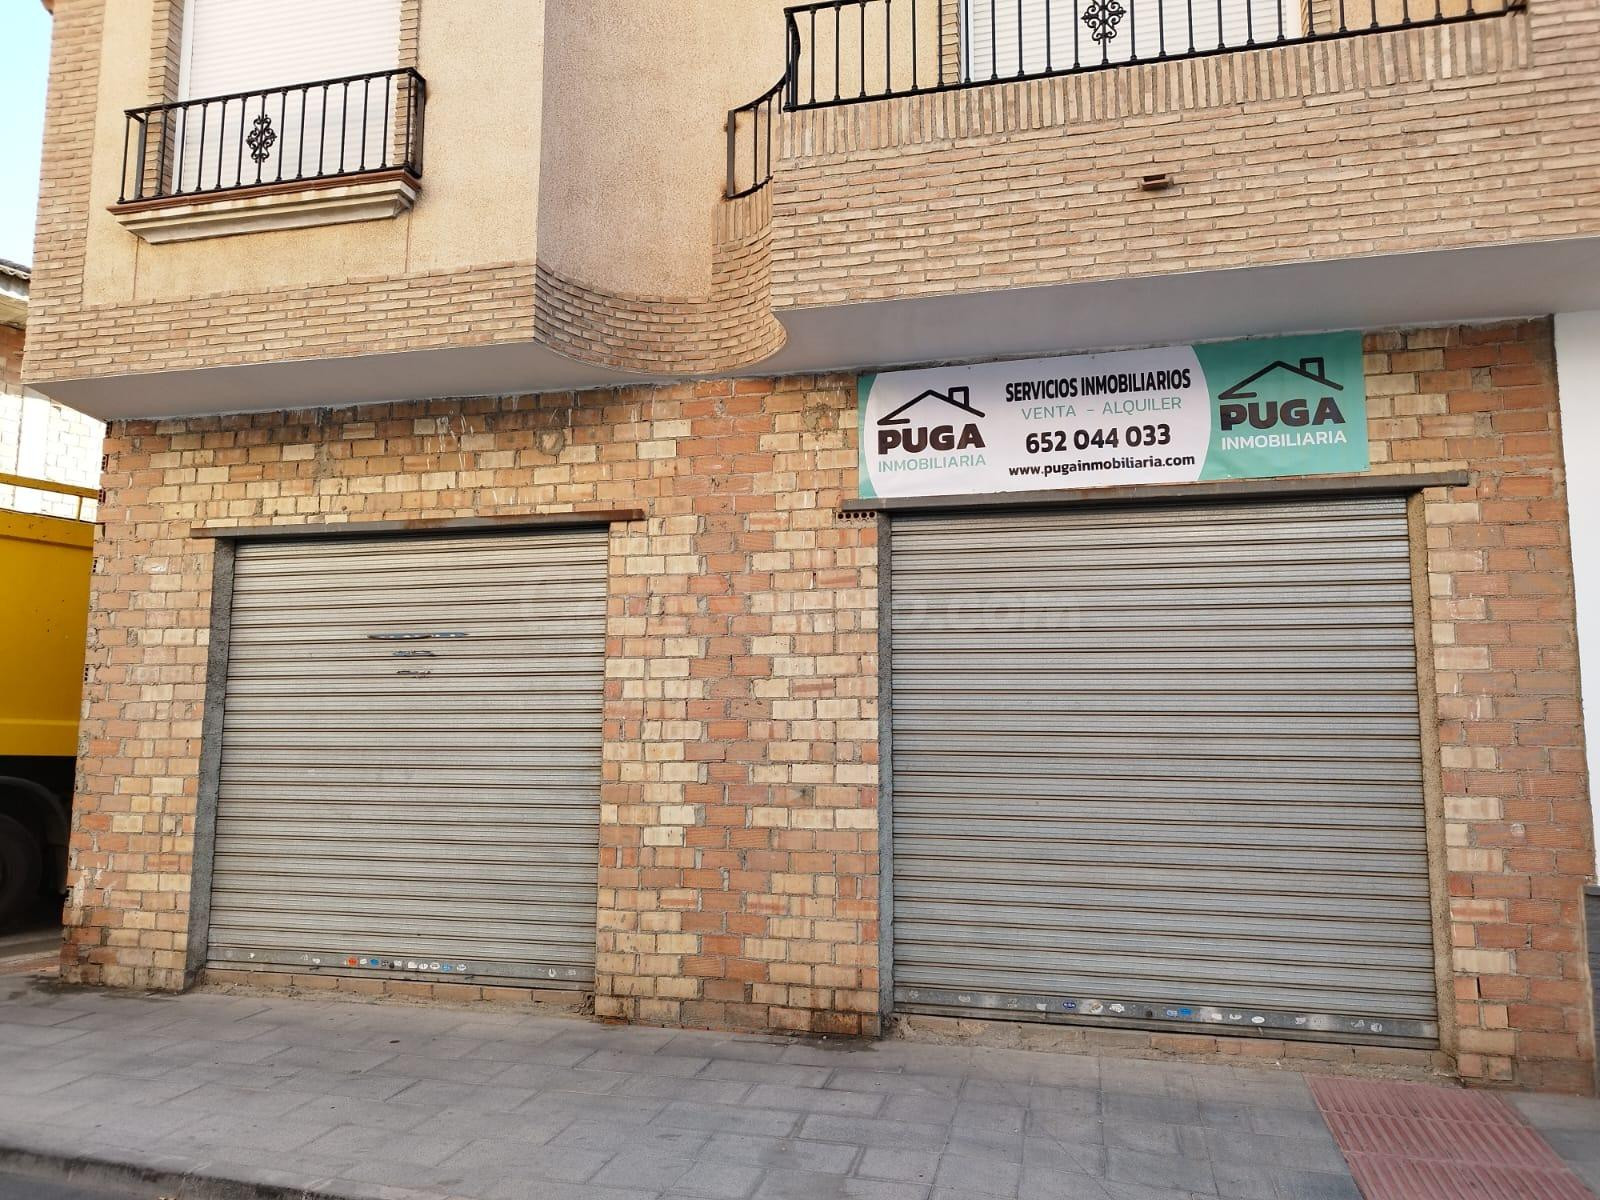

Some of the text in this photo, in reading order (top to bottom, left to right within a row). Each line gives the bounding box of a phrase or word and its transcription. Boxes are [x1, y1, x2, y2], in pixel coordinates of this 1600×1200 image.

[1005, 368, 1191, 402] SERVICIOS INMOBILIARIOS
[1021, 404, 1077, 420] VENTA
[1102, 396, 1182, 415] ALQUILER
[1219, 397, 1346, 430] PUGA
[878, 423, 985, 454] PUGA
[1025, 423, 1171, 453] 652 044 033
[1221, 430, 1347, 450] INMOBILIARIA
[878, 454, 986, 472] INMOBILIARIA
[1008, 455, 1195, 477] www.pugainmobiliaria.com
